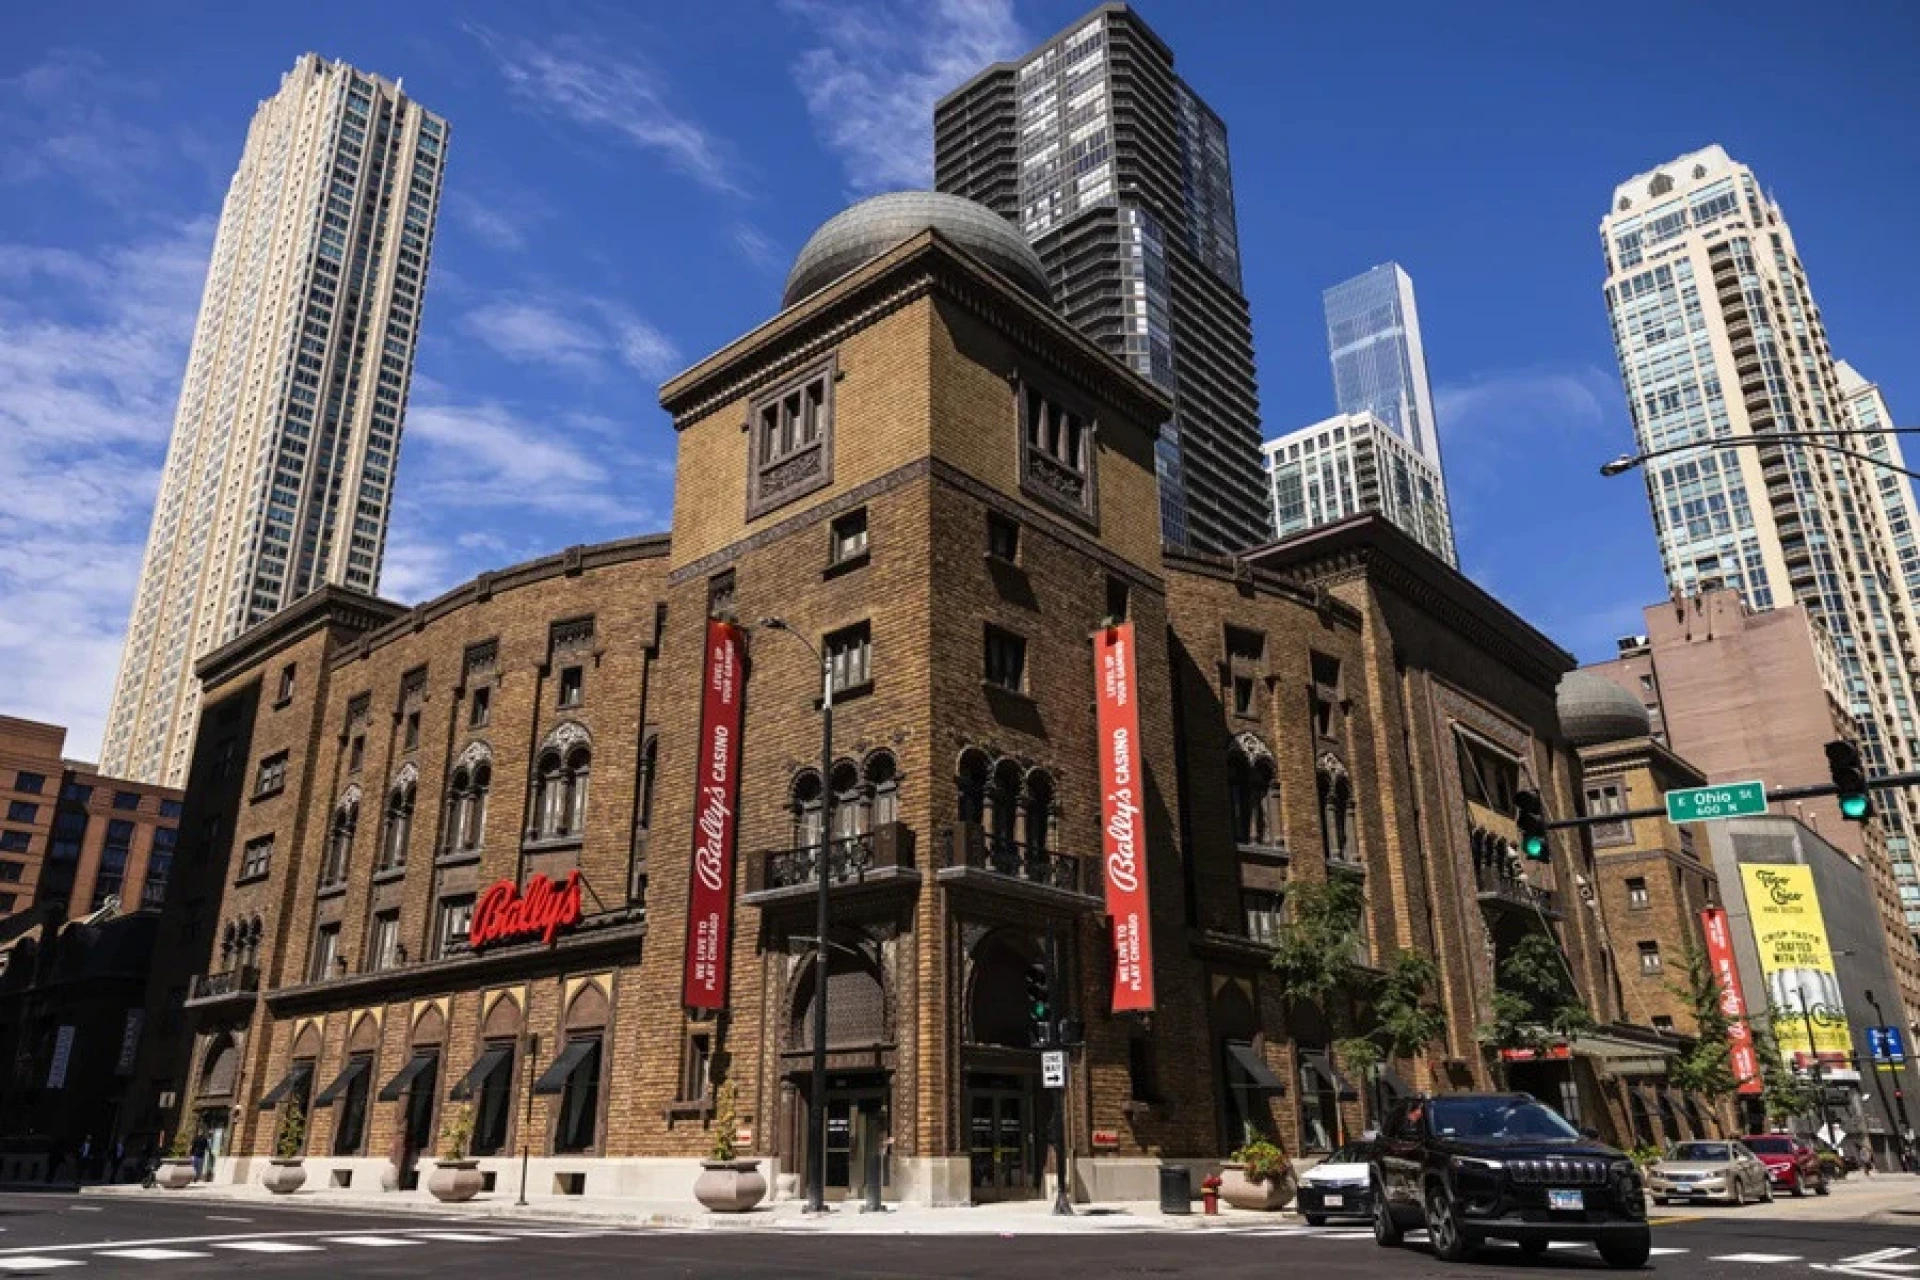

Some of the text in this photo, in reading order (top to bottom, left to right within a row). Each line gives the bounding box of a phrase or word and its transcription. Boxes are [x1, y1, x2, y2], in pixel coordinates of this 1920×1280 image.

[695, 725, 731, 890] Bally's CASINO
[1107, 727, 1140, 892] Bally's CASINO
[1678, 789, 1752, 807] E Ohio St
[1696, 803, 1738, 815] 600 N
[469, 868, 581, 947] Bally's
[705, 912, 719, 990] PLAY CHICAGO
[1128, 912, 1142, 991] PLAY CHICAGO
[1044, 1064, 1060, 1072] WAY
[1045, 1055, 1060, 1063] ONE
